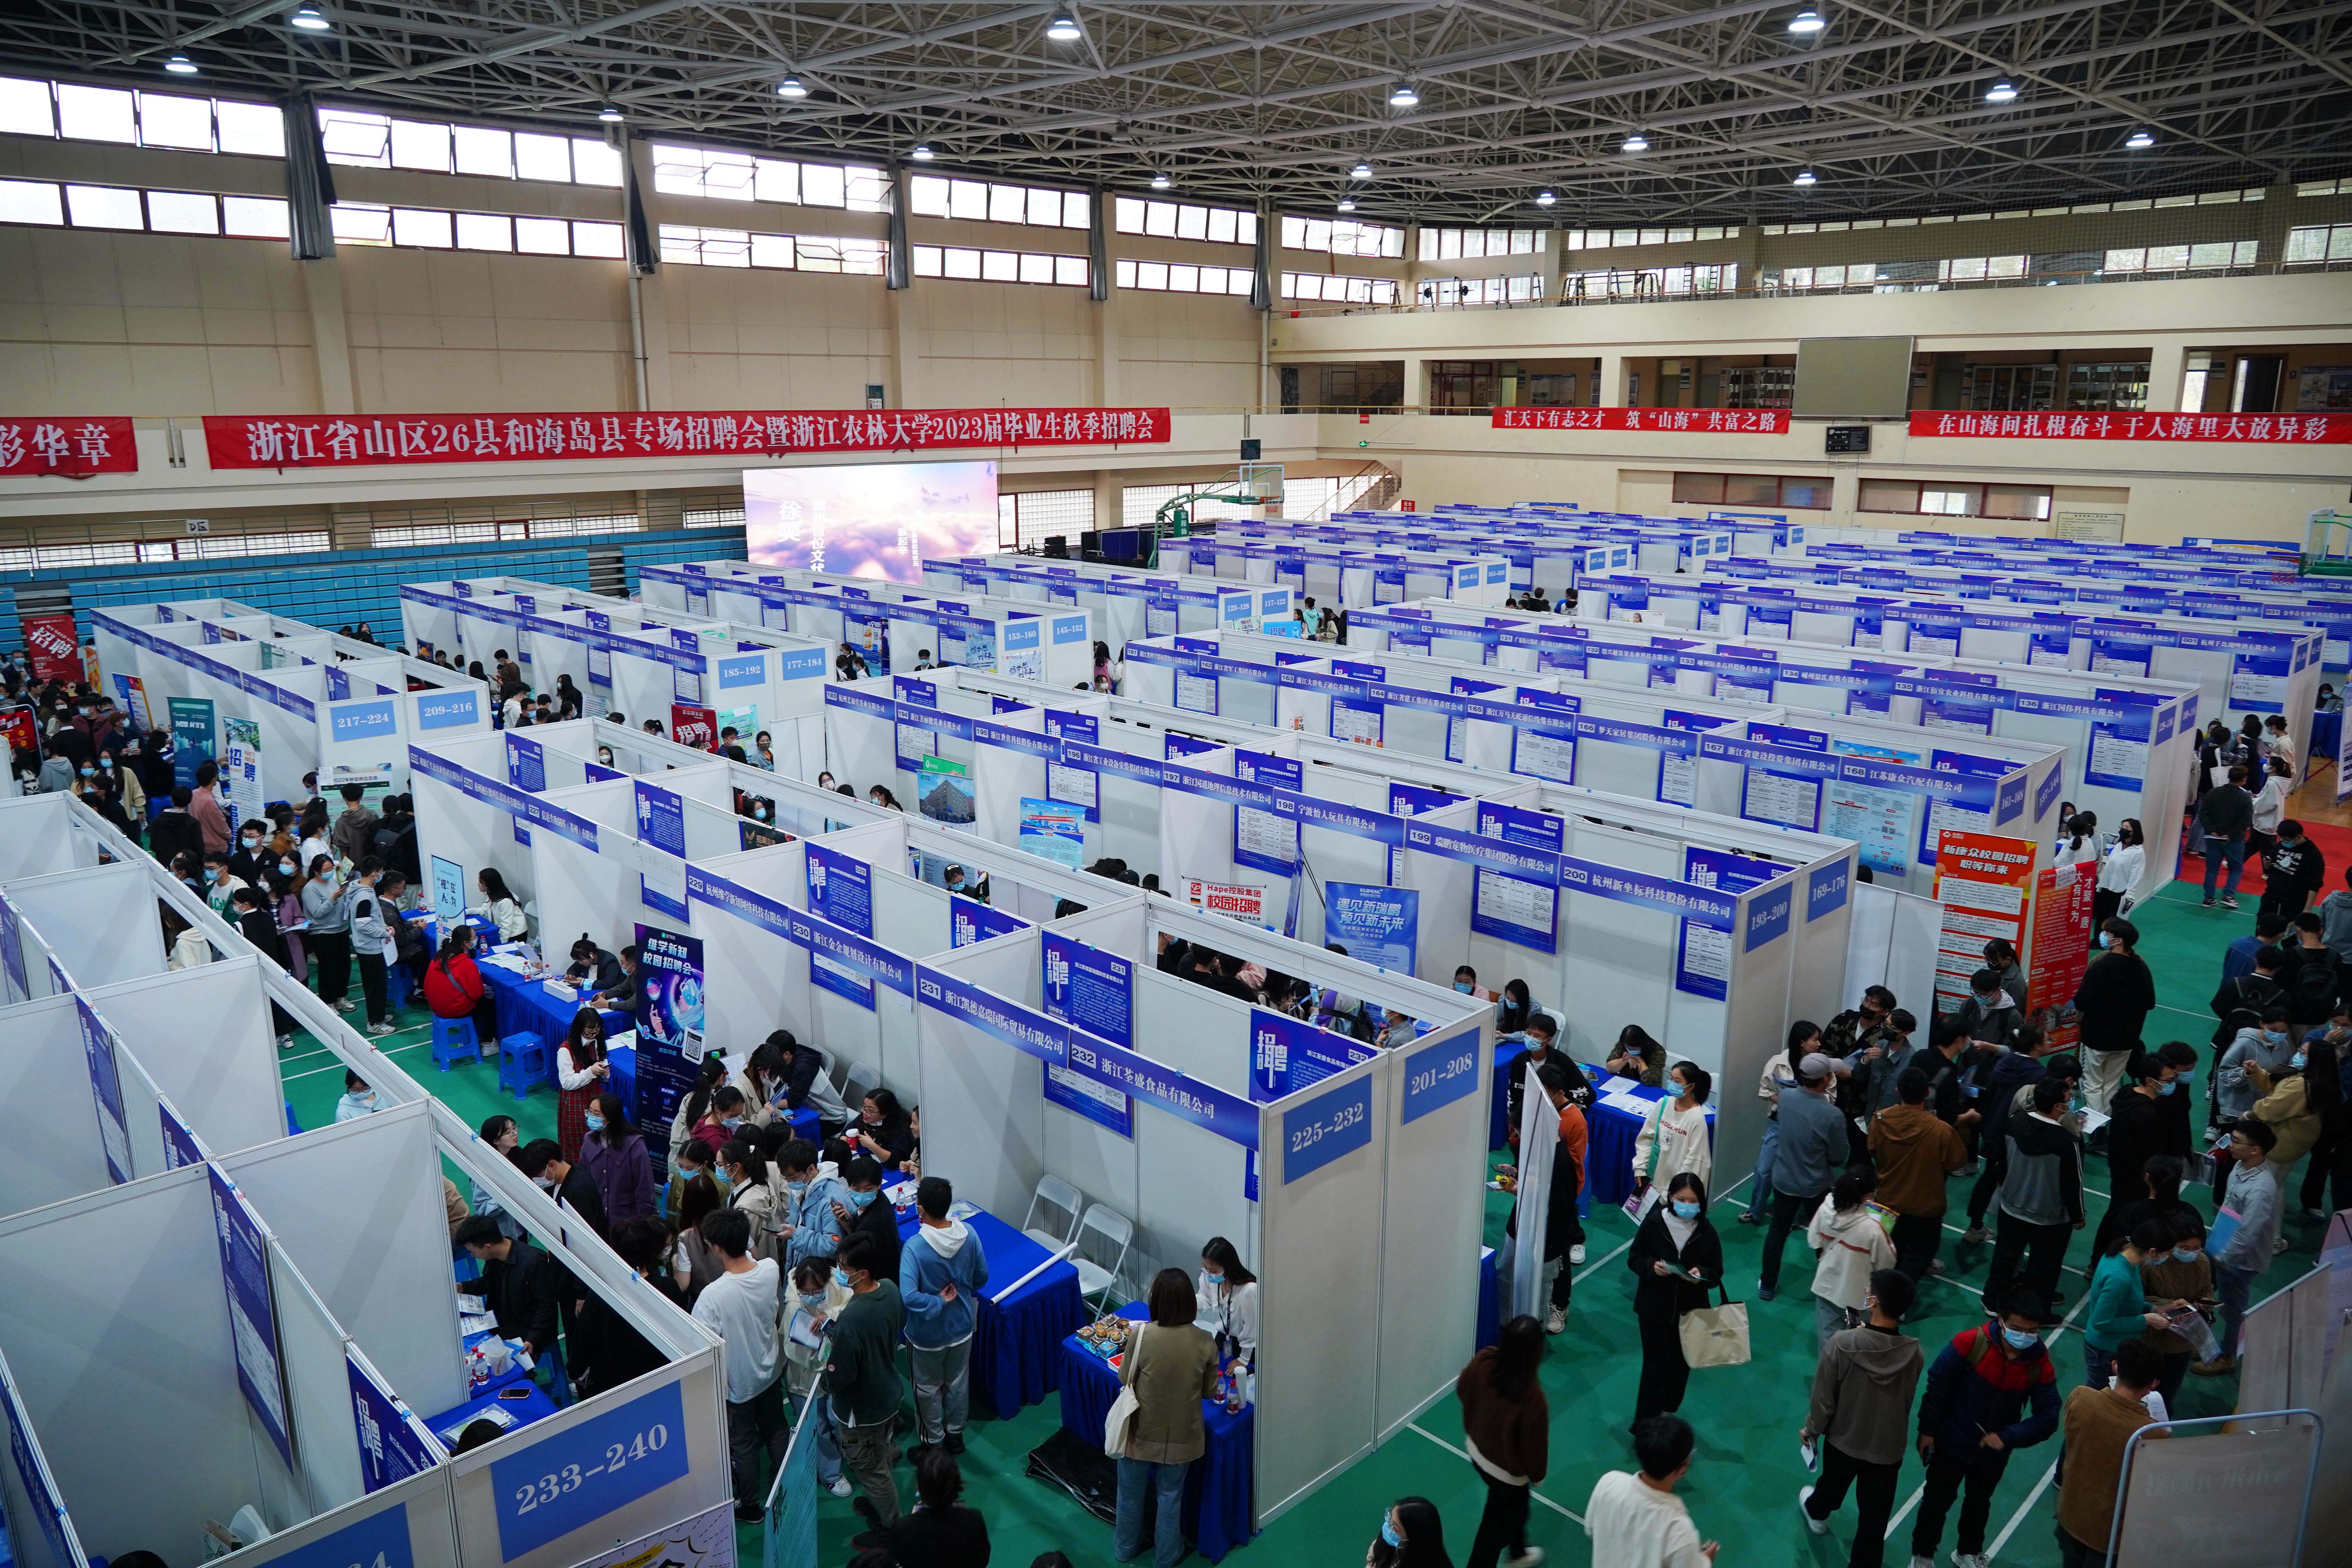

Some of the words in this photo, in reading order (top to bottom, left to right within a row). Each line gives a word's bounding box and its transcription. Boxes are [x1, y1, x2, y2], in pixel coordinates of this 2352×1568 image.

[1504, 410, 1606, 428] 汇天下有志之才
[1937, 414, 2112, 438] 在山海间扎根奋斗
[2123, 416, 2327, 442] 于人海里大放异彩
[0, 423, 112, 468] 彩华章
[247, 410, 1154, 461] 浙江省山区26县和海岛县专场招聘会暨浙江农林大学2023届毕业生秋季招聘会
[189, 522, 208, 531] D区
[1227, 603, 1250, 613] 123-128
[1265, 598, 1286, 607] 117-122
[1008, 630, 1036, 642] 153-160
[1056, 624, 1083, 635] 145-152
[30, 627, 73, 659] 招聘
[2201, 639, 2276, 655] 杭州千岛湖啤酒有限公司
[723, 665, 761, 678] 185-192
[786, 657, 822, 669] 177-184
[1214, 663, 1267, 679] 浙江省军工集团有限公司
[1296, 677, 1360, 694] 浙江大唐电子通信有限公司
[423, 702, 472, 717] 209-216
[1387, 692, 1463, 711] 浙江省建工集团有限责任公司
[337, 713, 389, 728] 217-224
[676, 722, 712, 739] 招聘
[911, 713, 960, 732] 浙江美丽健乳业有限公司
[991, 731, 1053, 752] 浙江世佳科技股份有限公司
[1599, 726, 1686, 748] 梦天家居集团股份有限公司
[1083, 753, 1160, 778] 浙江省工业设备安装集团有限公司
[1728, 746, 1835, 771] 浙江省建设投资集团有限公司
[1165, 771, 1178, 780] 197
[1183, 775, 1271, 804] 浙江国遥地理信息技术有限公司
[1846, 767, 1864, 775] 168
[1870, 770, 1962, 796] 江苏康众汽配有限公司
[2001, 789, 2024, 810] 161-168
[529, 806, 539, 816] 227
[1278, 800, 1293, 810] 198
[1298, 805, 1375, 833] 宁波怡人玩具有限公司
[1412, 831, 1429, 842] 199
[1435, 837, 1553, 873] 瑞鹏宠物医疗集团股份有限公司
[1943, 844, 2029, 865] 新康众校园招聘
[857, 866, 866, 875] 229
[1959, 859, 2009, 875] 职等你来
[1207, 884, 1261, 898] Hape控股集团
[1566, 869, 1586, 881] 200
[1593, 875, 1730, 917] 杭州新坐标科技股份有限公司
[1812, 874, 1846, 902] 169-176
[2070, 871, 2083, 922] 大有可为
[690, 878, 702, 890] 229
[706, 884, 788, 929] 杭州维学新知网络科技有限公司
[1207, 894, 1261, 915] 校园招聘
[1336, 897, 1402, 916] 遇见新瑞鹏
[2080, 877, 2093, 929] 才聚一唐
[1339, 911, 1405, 933] 预见新未来
[1751, 901, 1788, 931] 193-200
[647, 938, 687, 959] 维学新知
[795, 924, 809, 938] 230
[813, 931, 901, 981] 浙江金余规划设计有限公司
[642, 952, 692, 975] 校园招聘会
[1112, 964, 1124, 973] 231
[1047, 949, 1069, 1000] 招聘
[922, 982, 939, 996] 231
[946, 991, 1063, 1053] 浙江凯德嘉瑞国际贸易有限公司
[1257, 1030, 1287, 1089] 招聘
[1350, 1051, 1368, 1062] 232
[1074, 1047, 1094, 1065] 232
[1102, 1058, 1214, 1118] 浙江荃盛食品有限公司
[1411, 1053, 1473, 1095] 201-208
[1292, 1102, 1364, 1153] 225-232
[516, 1424, 668, 1516] 233-240
